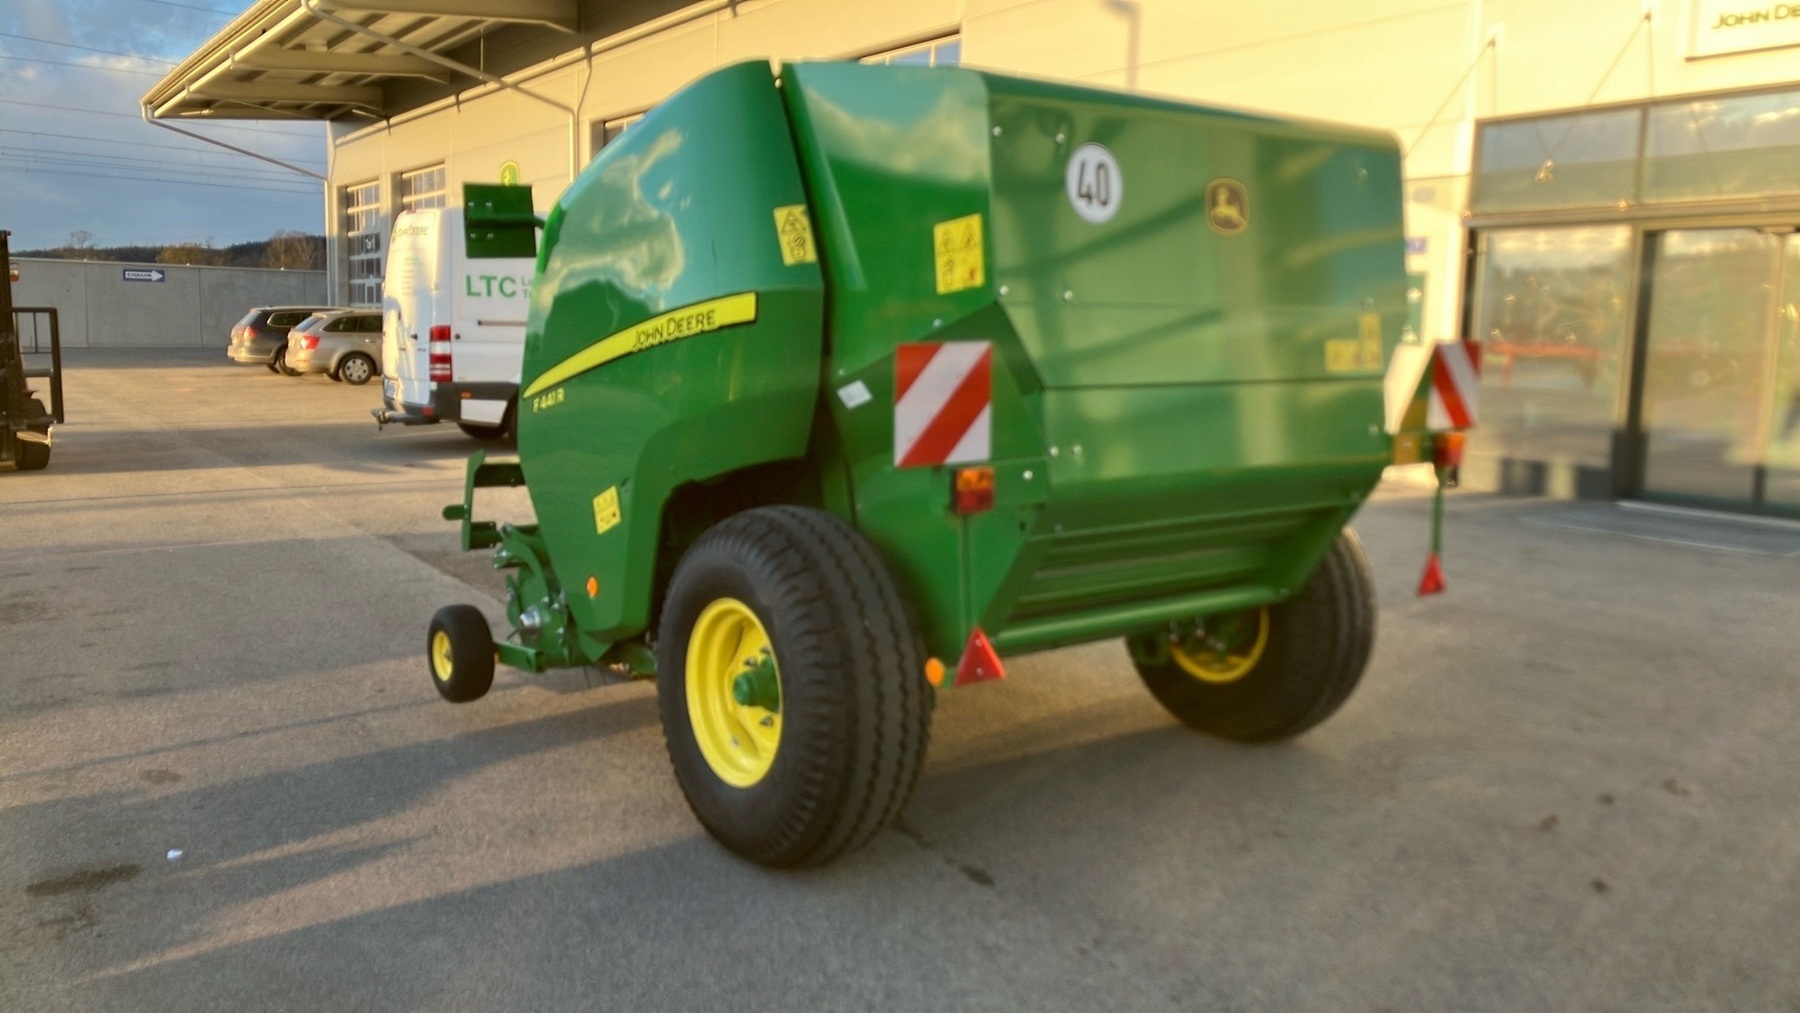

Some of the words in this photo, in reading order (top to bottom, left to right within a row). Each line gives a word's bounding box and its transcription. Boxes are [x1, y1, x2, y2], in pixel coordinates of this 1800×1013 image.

[1711, 10, 1769, 29] JOHN
[1077, 160, 1109, 207] 40
[465, 275, 517, 298] LTC
[633, 324, 663, 348] JOHN
[666, 309, 715, 336] DEERE
